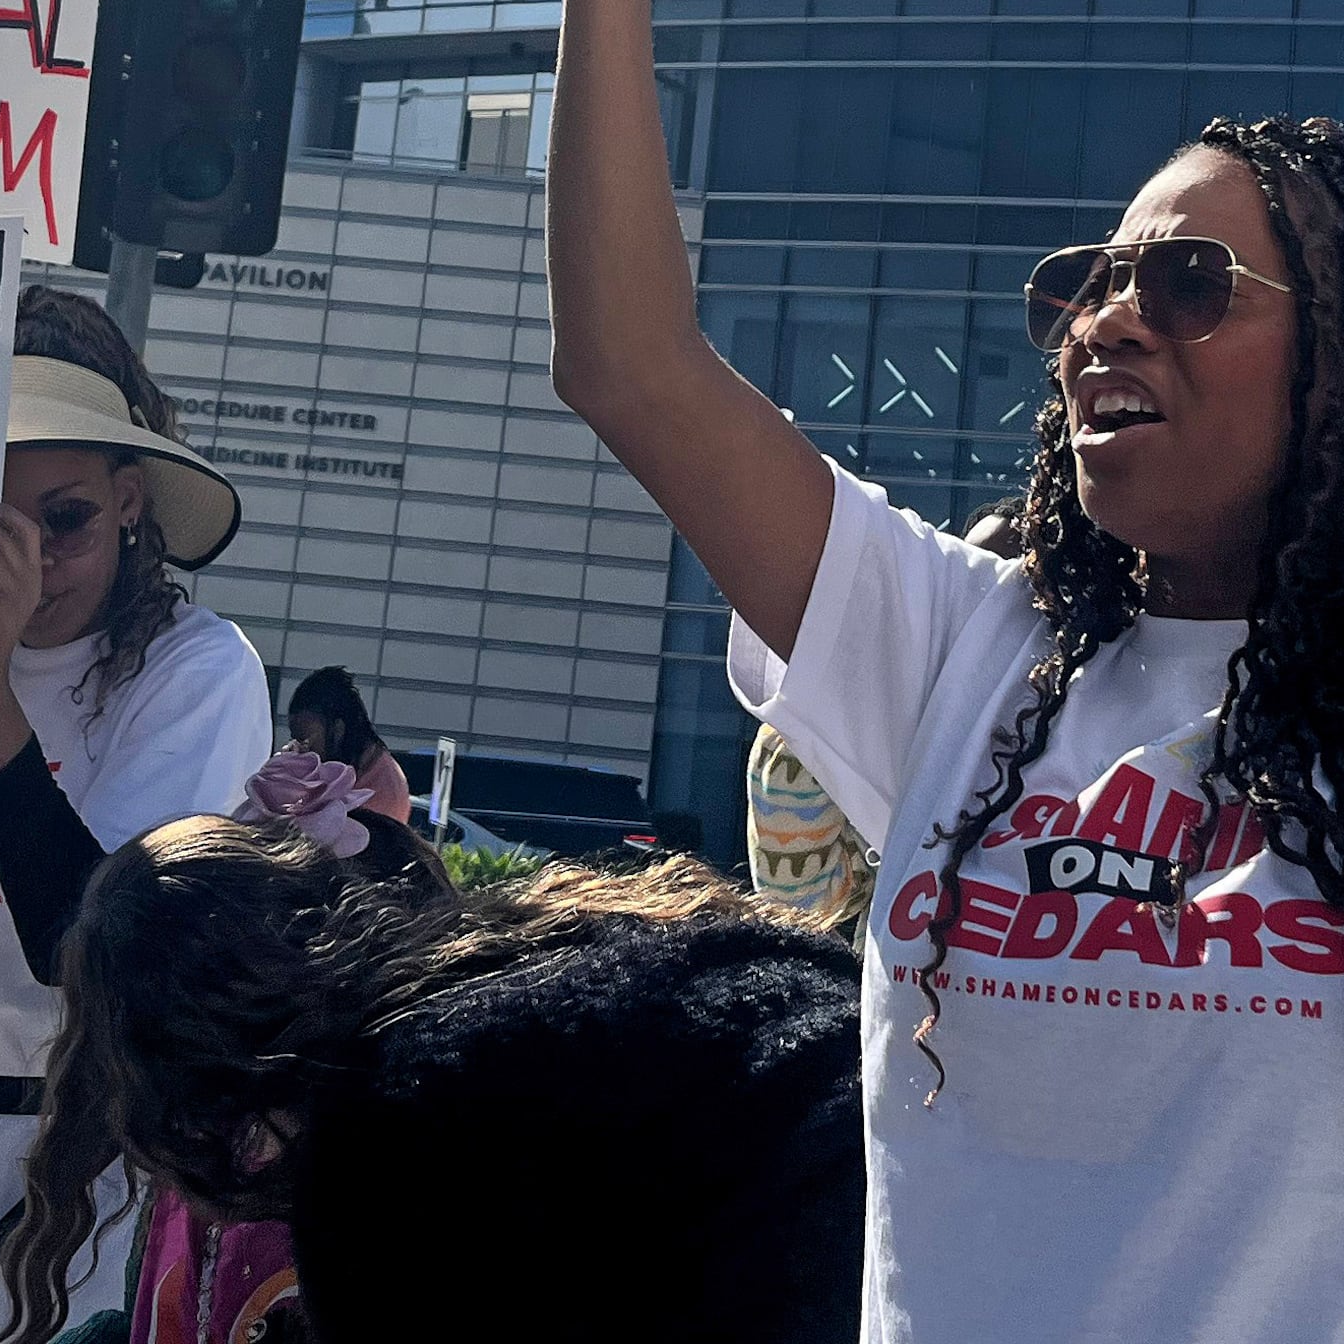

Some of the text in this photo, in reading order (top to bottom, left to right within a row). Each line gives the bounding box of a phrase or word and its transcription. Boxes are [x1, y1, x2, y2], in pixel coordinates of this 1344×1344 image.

[205, 261, 328, 291] AVILION
[292, 407, 377, 431] CENTER
[295, 454, 404, 480] INSTITUTE
[1049, 844, 1155, 893] ON
